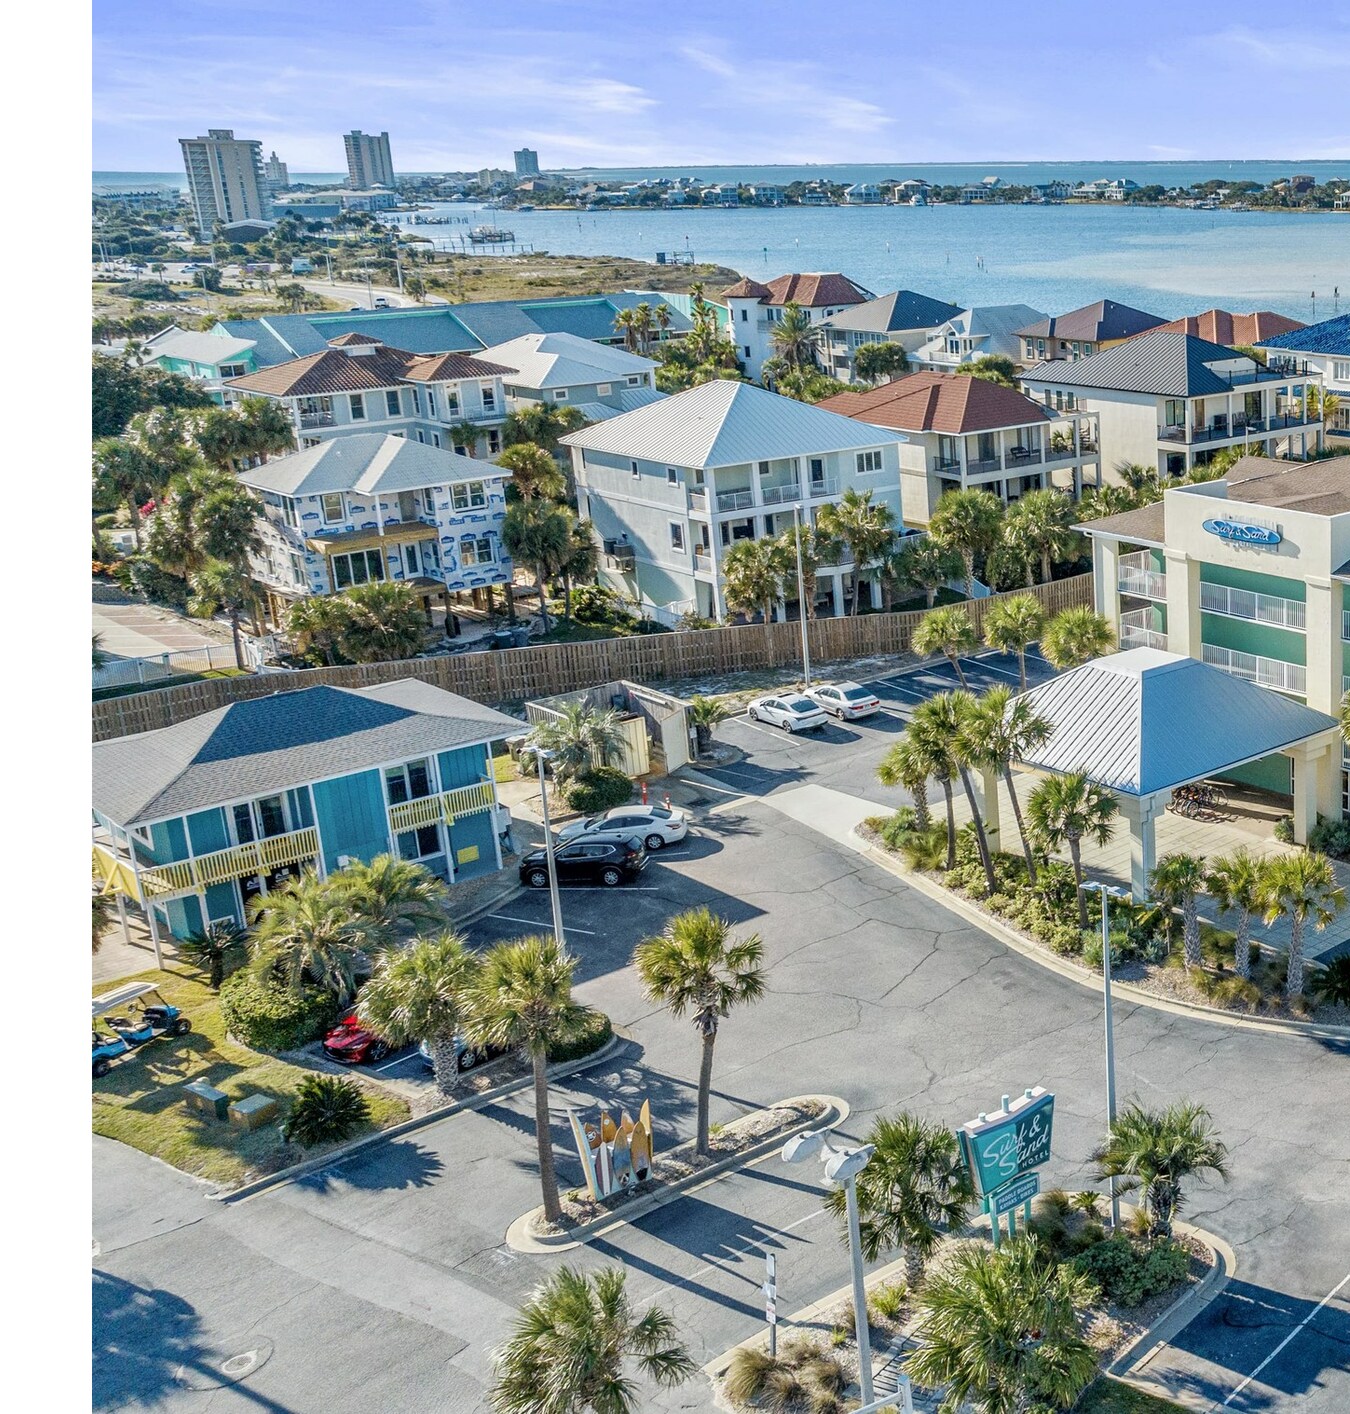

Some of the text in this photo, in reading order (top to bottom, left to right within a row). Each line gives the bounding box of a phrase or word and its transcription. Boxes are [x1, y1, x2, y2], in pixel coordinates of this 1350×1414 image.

[1212, 520, 1269, 541] Surf & Sand
[983, 1114, 1042, 1168] Surf &
[999, 1123, 1050, 1176] Sand
[1022, 1149, 1049, 1168] HOTEL
